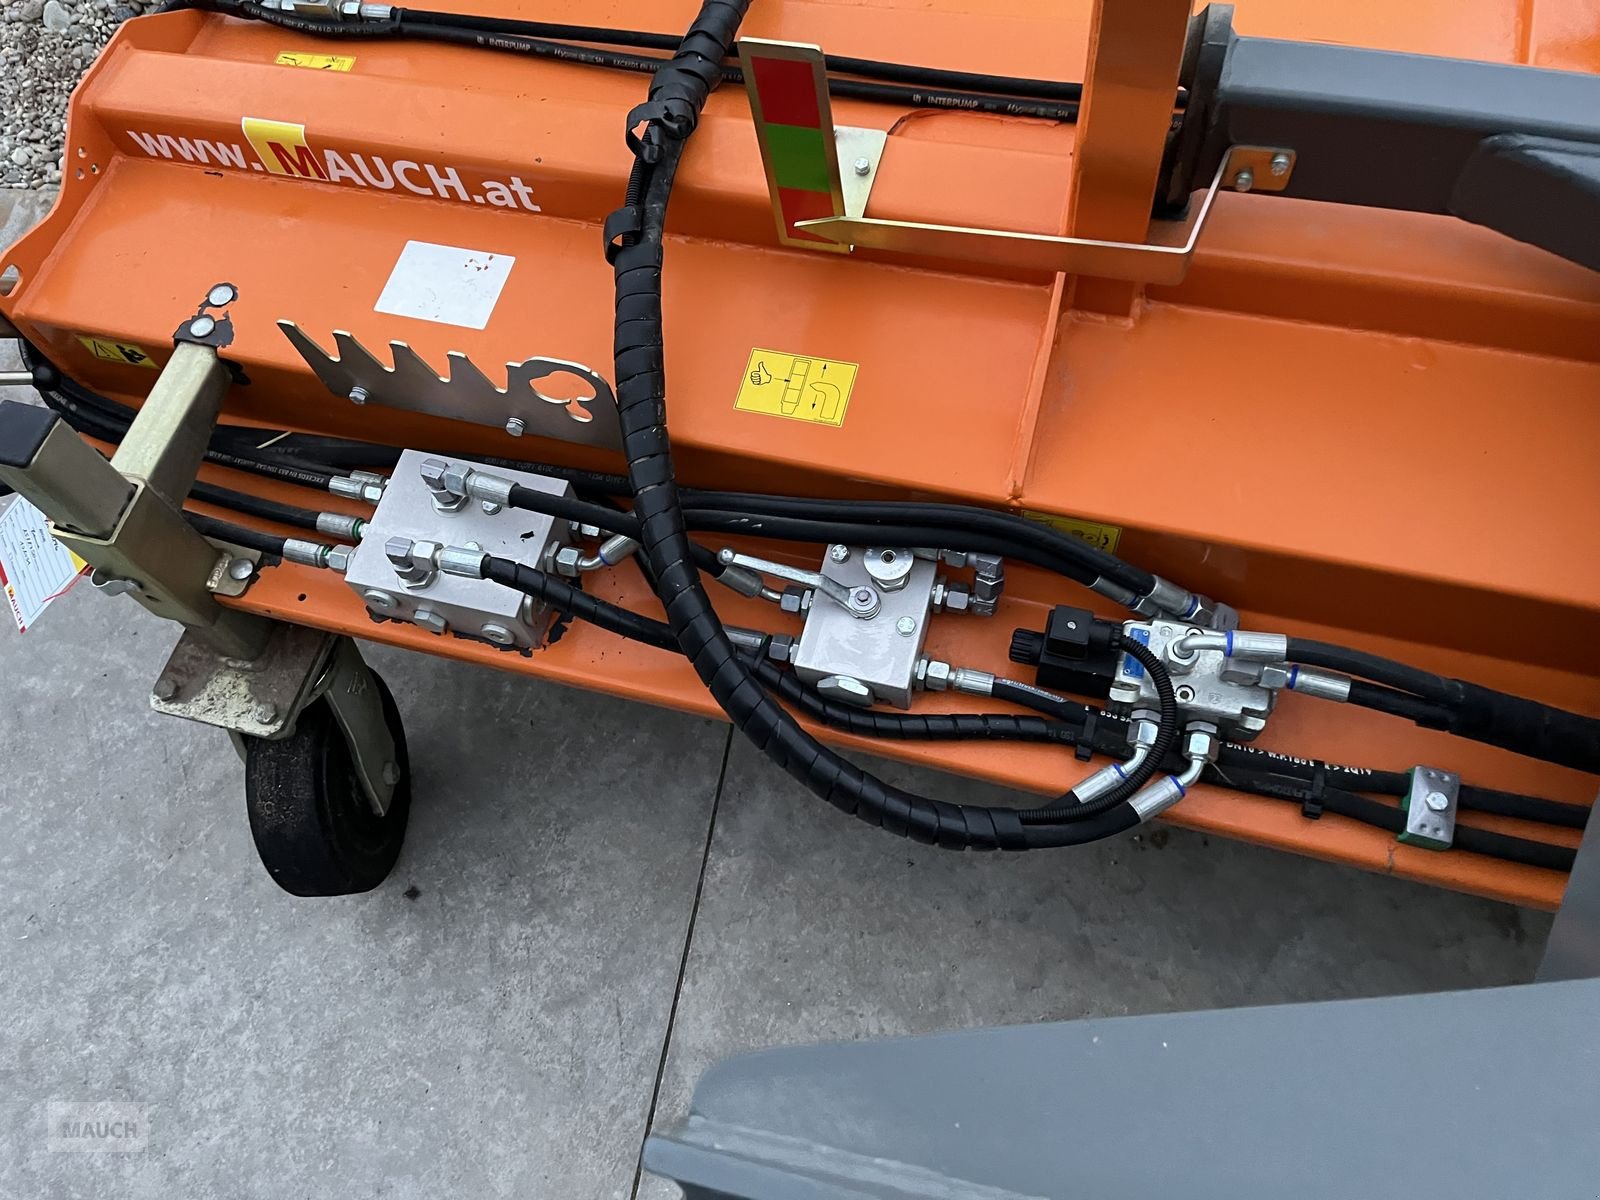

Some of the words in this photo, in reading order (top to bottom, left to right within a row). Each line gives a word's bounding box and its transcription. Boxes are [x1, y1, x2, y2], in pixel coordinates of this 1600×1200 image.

[488, 38, 530, 51] INTERPUMP
[928, 96, 979, 109] INTERPUMP
[127, 130, 542, 212] www.MAUCH.at
[288, 470, 298, 478] EN
[298, 472, 325, 484] EXCEEDS
